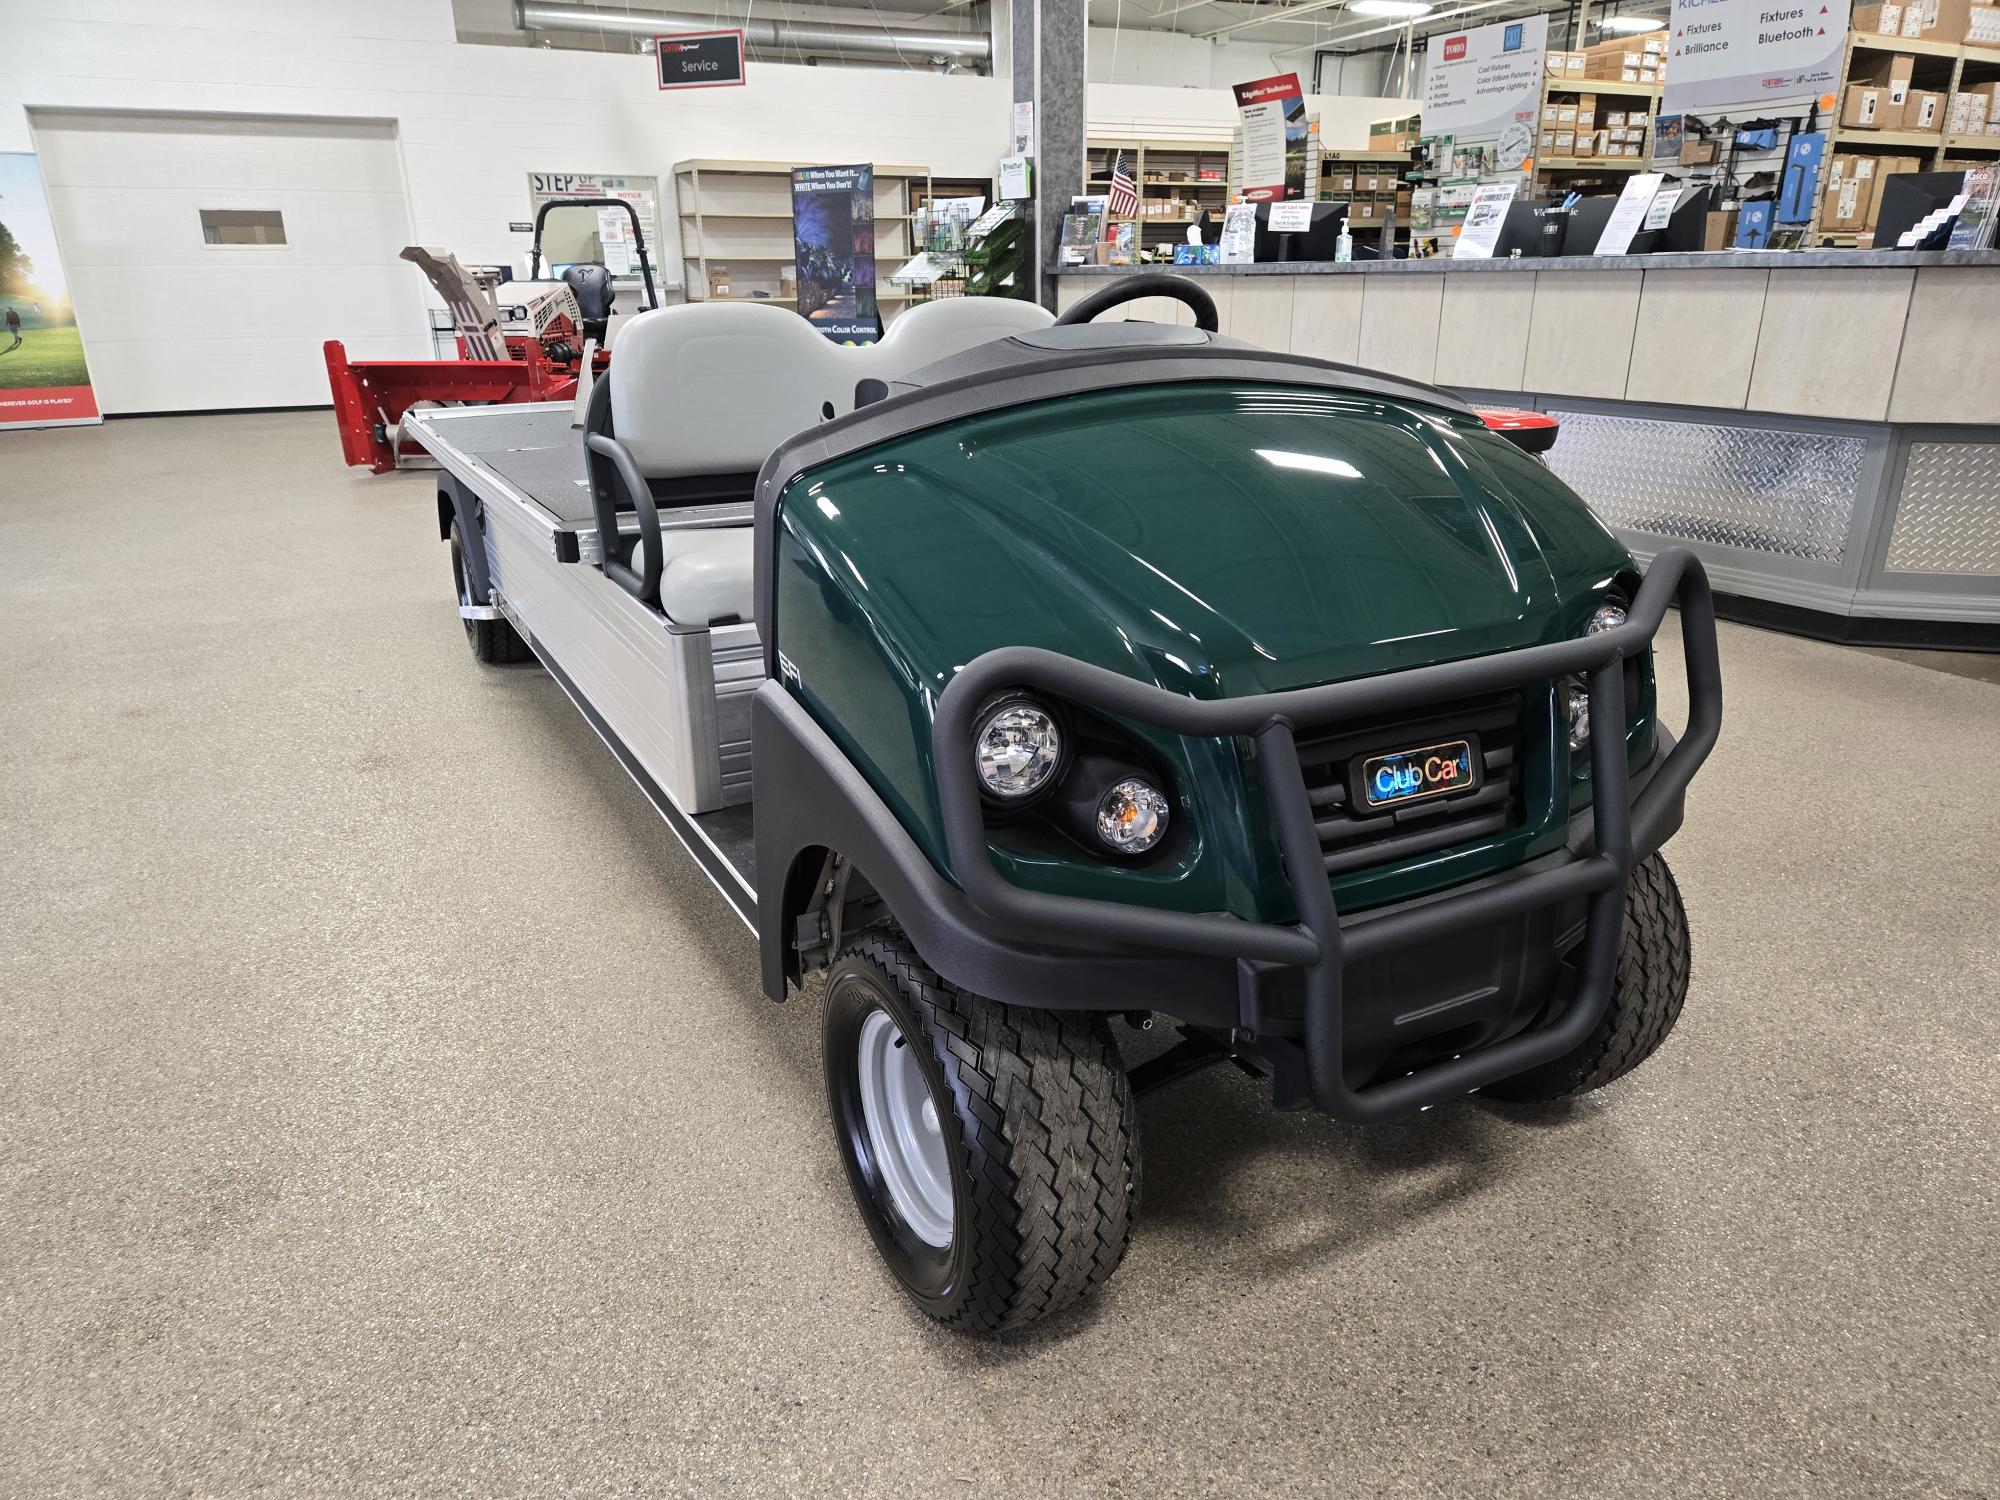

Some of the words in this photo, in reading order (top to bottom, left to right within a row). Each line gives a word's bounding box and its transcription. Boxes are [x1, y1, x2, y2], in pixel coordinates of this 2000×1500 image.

[1760, 9, 1804, 24] Fixtures
[1686, 22, 1722, 36] Fixtures
[1758, 26, 1813, 45] Bluetooth
[1685, 41, 1729, 55] Brilliance
[682, 60, 718, 72] Service
[1477, 66, 1491, 74] Cast
[1491, 63, 1511, 73] Fixtures
[1476, 76, 1491, 85] Color
[1491, 74, 1509, 82] Edison
[1510, 71, 1531, 79] Fixtures
[1476, 84, 1506, 95] Advantage
[1506, 82, 1528, 92] Lighting
[810, 171, 825, 179] When
[825, 170, 835, 178] You
[834, 169, 850, 178] Want
[1967, 170, 1988, 181] Kasco
[534, 175, 573, 191] STEP
[794, 182, 811, 191] WHITE
[811, 182, 826, 190] When
[826, 181, 836, 189] You
[617, 191, 642, 199] NOTICE
[831, 324, 851, 334] COLOR
[851, 324, 877, 334] CONTROL
[778, 649, 802, 690] EFI
[1376, 762, 1424, 792] Club
[1425, 757, 1460, 782] Car
